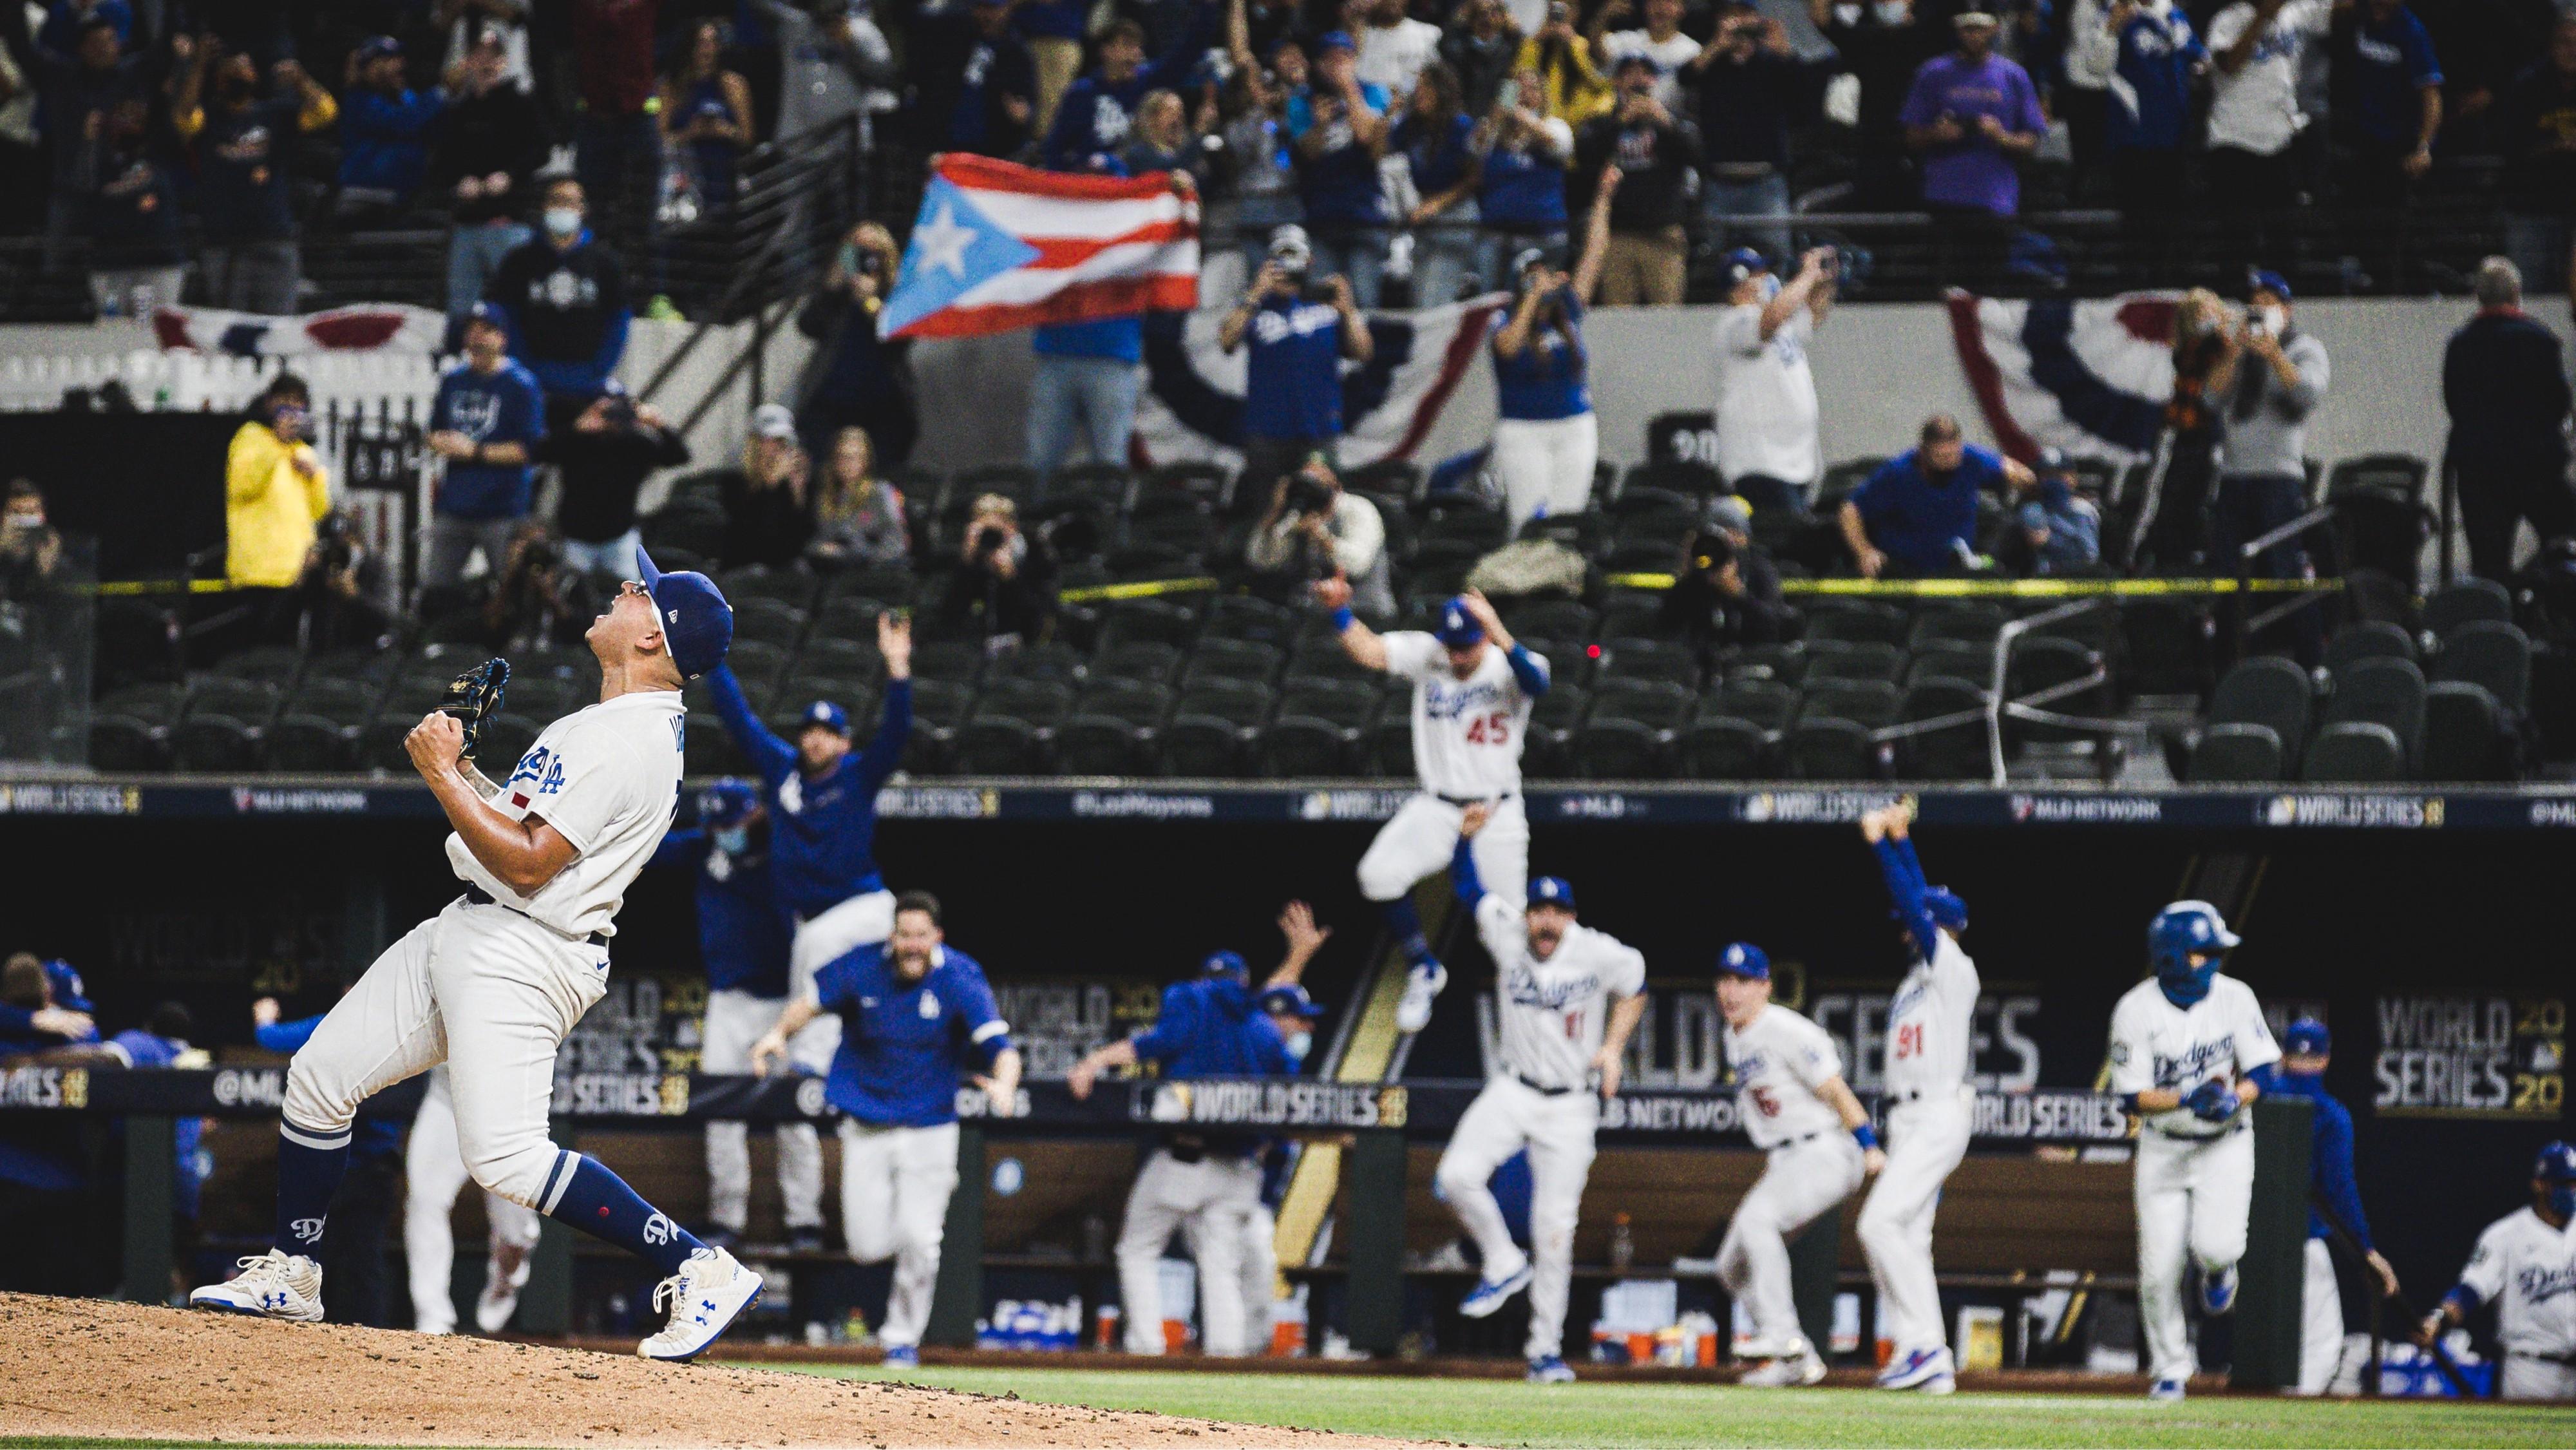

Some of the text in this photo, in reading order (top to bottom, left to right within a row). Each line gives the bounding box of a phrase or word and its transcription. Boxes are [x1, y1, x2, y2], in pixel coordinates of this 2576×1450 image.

[1466, 710, 1510, 746] 45
[538, 754, 565, 794] LA
[2075, 799, 2161, 821] NETWORK
[2297, 795, 2361, 826] WORLD
[2362, 796, 2423, 827] SERIES
[2376, 998, 2510, 1049] WORLD
[2372, 1049, 2564, 1112] SERIES 20
[1193, 1082, 1287, 1124] WORLD
[1288, 1083, 1379, 1128] SERIES
[2032, 1094, 2126, 1139] SERIES
